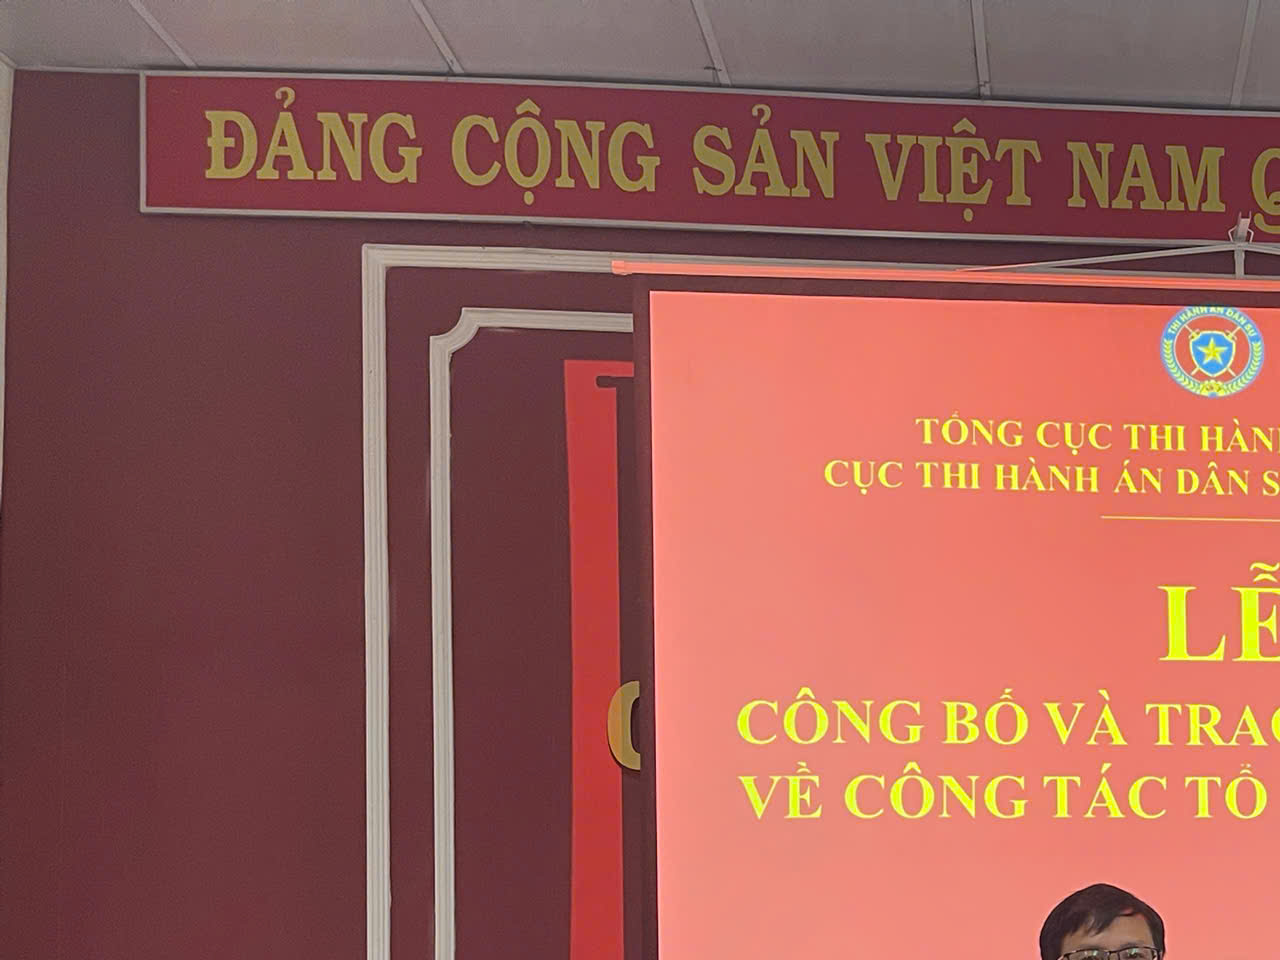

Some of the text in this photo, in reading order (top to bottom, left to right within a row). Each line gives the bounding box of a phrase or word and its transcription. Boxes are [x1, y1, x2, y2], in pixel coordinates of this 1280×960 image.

[205, 86, 422, 184] ĐẢNG
[451, 98, 660, 204] CỘNG
[692, 104, 838, 199] SẢN
[865, 117, 1042, 223] VIỆT
[1067, 141, 1226, 213] NAM
[915, 411, 1024, 447] TỔNG
[1036, 421, 1112, 455] CỤC
[1123, 423, 1185, 452] THI
[824, 459, 904, 495] CỤC
[915, 461, 981, 489] THI
[995, 457, 1100, 493] HÀNH
[1114, 459, 1163, 494] ÁN
[1176, 461, 1249, 496] DÂN
[736, 686, 924, 745] CÔNG
[942, 688, 1029, 746] BỐ
[1043, 688, 1128, 746] VÀ
[738, 760, 823, 820] VỀ
[844, 760, 1029, 820] CÔNG
[1042, 761, 1168, 820] TÁC
[1184, 763, 1268, 820] TỔ
